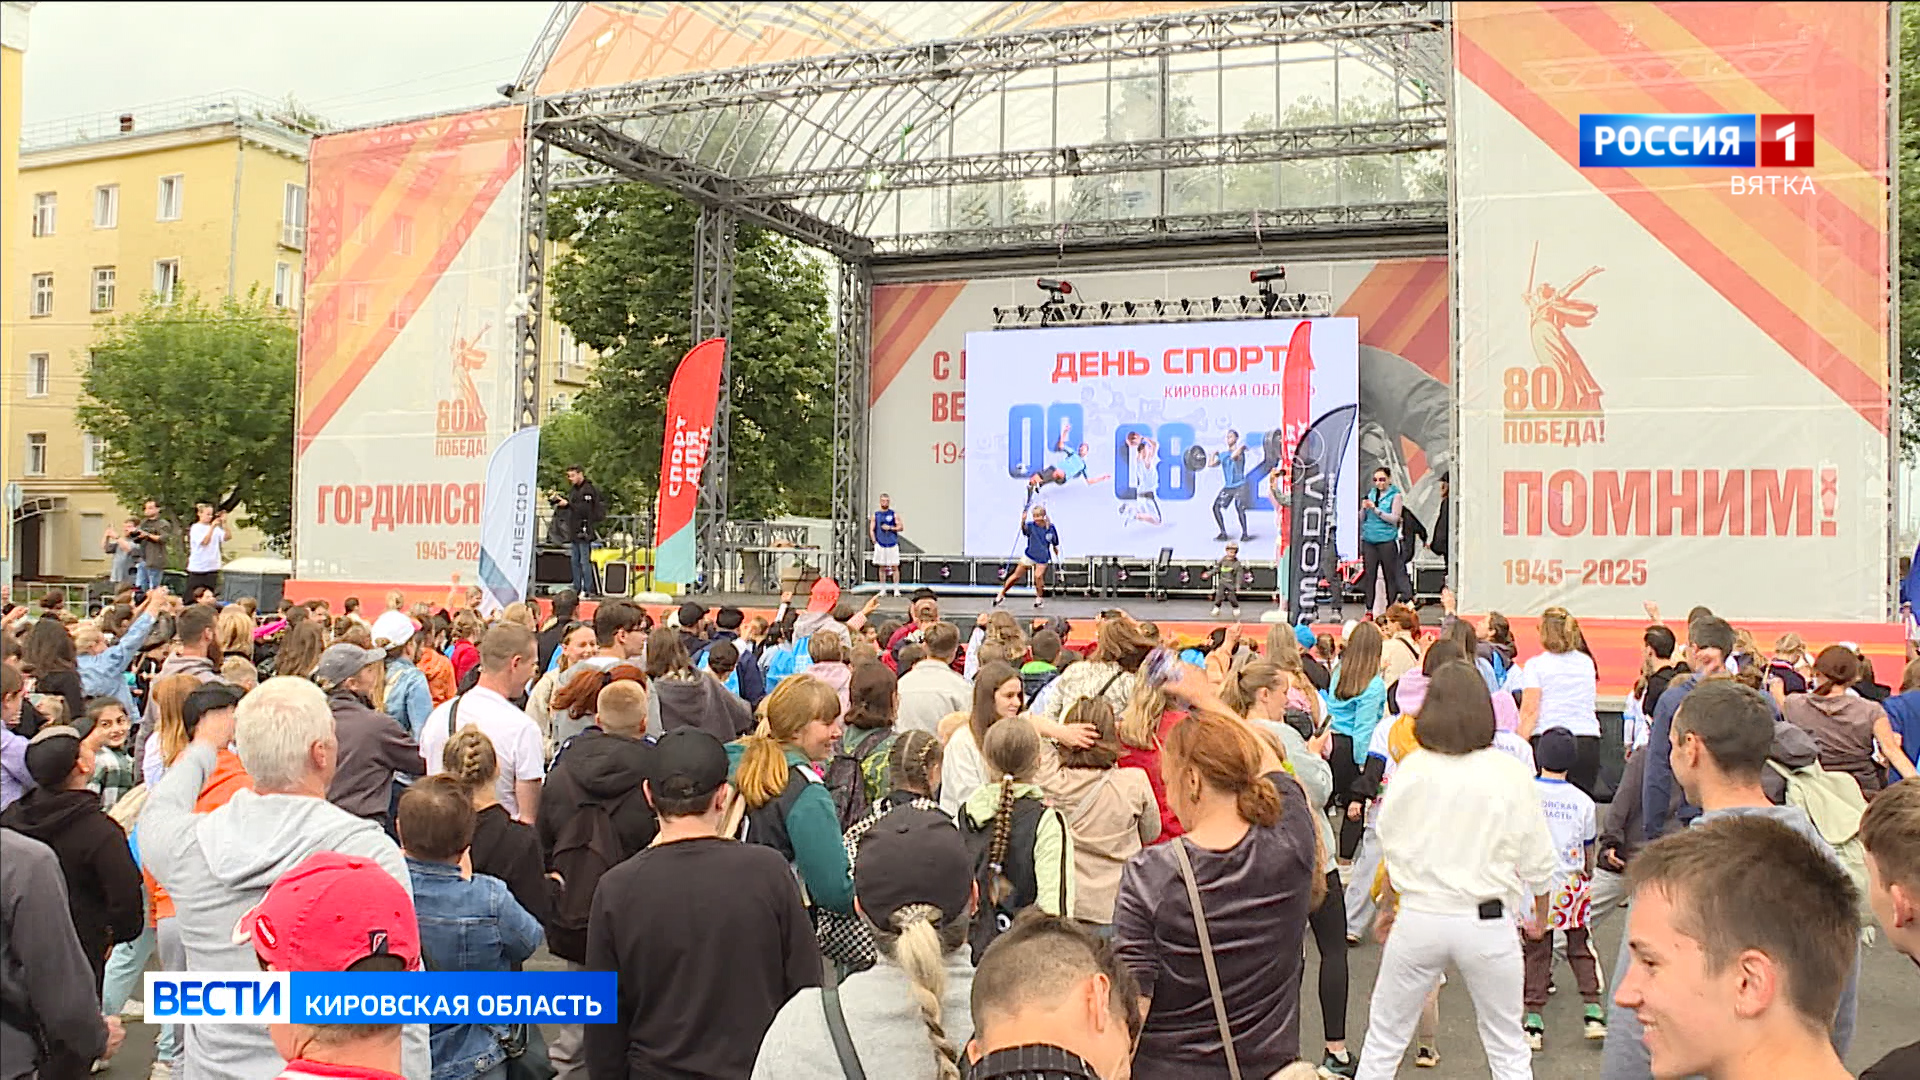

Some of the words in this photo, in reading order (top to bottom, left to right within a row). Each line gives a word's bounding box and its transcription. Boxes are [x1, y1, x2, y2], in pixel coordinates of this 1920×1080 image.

[1052, 350, 1150, 384] ДЕНЬ
[1163, 345, 1316, 374] СПОРТ
[1164, 383, 1248, 399] КИРОВСКАЯ
[1503, 366, 1558, 412] 80
[1503, 420, 1605, 448] ПОБЕДА!
[436, 439, 487, 458] ПОБЕДА!
[1503, 468, 1838, 538] ПОМНИМ!
[415, 541, 480, 560] 1945–202
